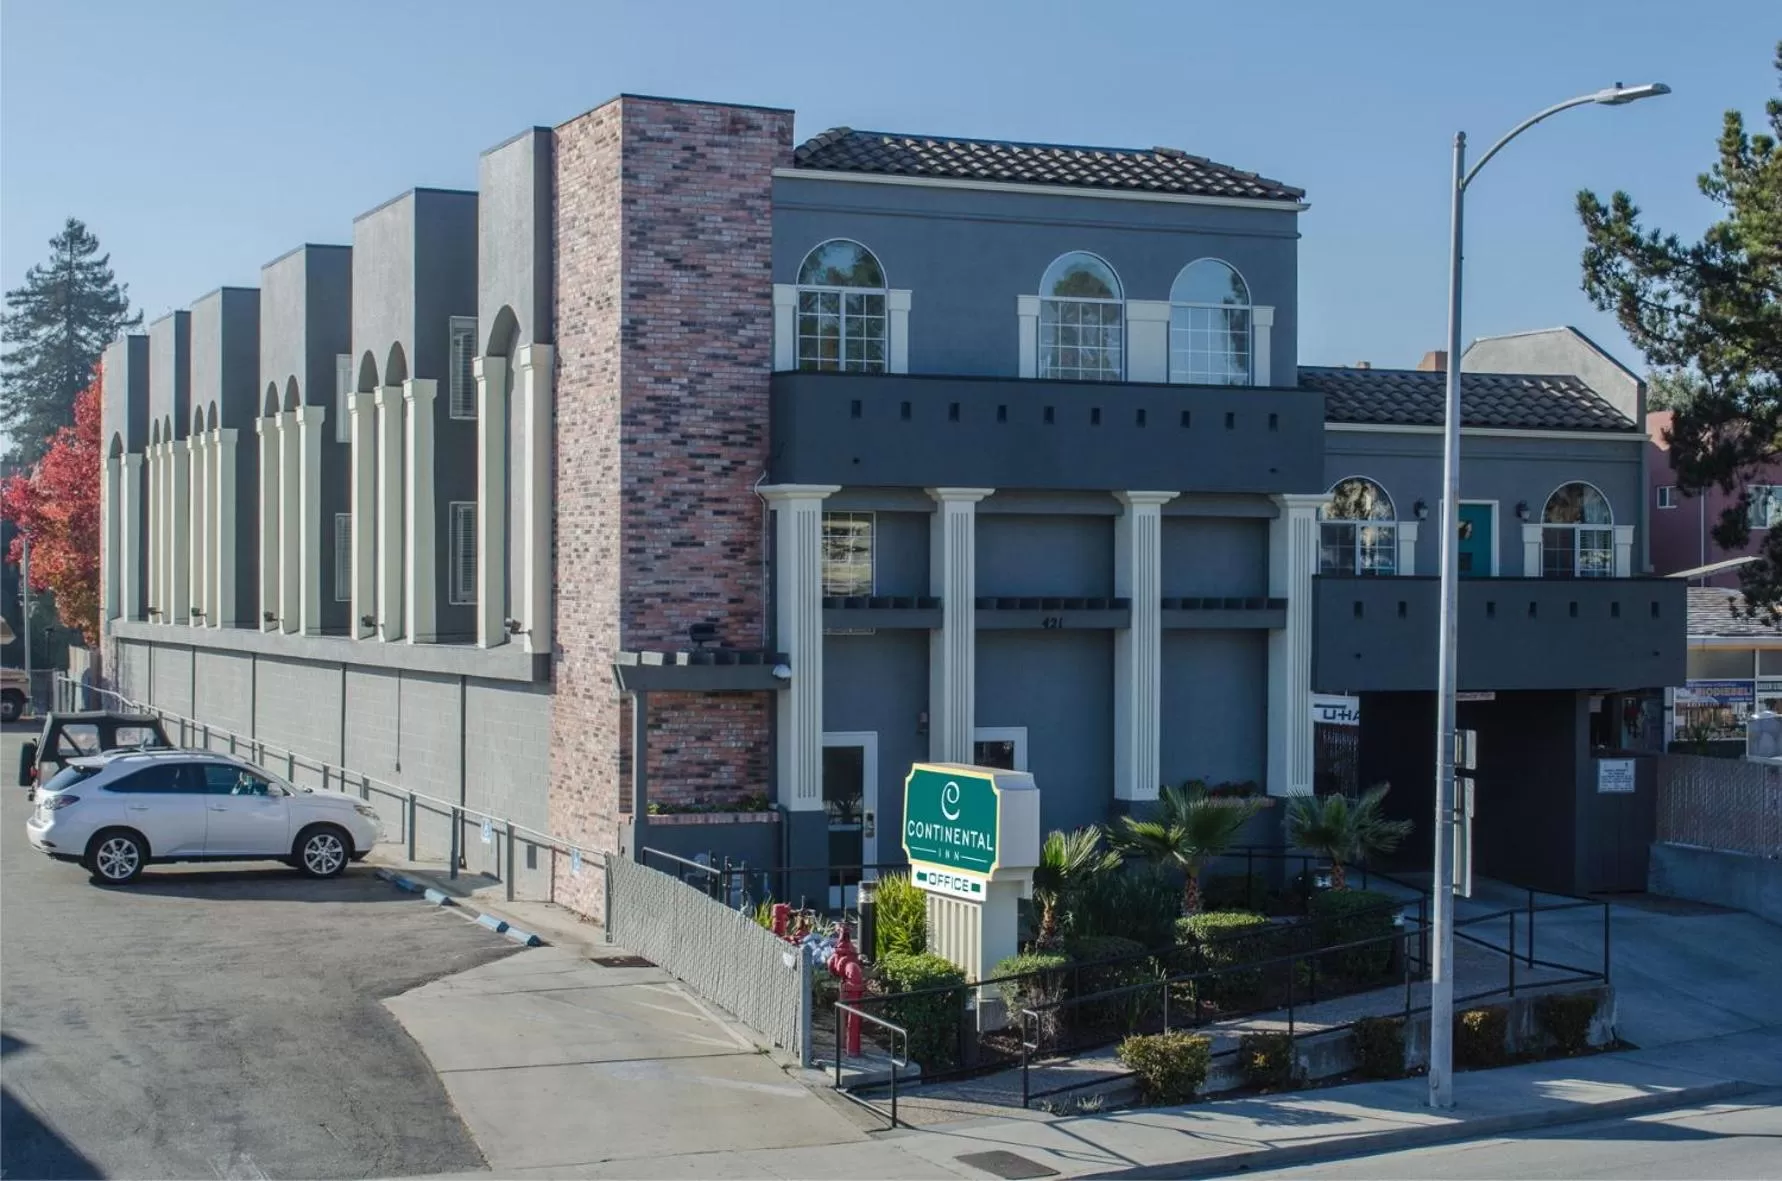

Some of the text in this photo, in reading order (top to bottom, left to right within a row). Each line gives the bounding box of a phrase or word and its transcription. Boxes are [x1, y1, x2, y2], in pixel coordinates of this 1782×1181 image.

[1041, 616, 1063, 629] 421
[907, 820, 994, 851] CONTINENTAL
[938, 847, 960, 861] INN
[928, 872, 969, 892] OFFICE
